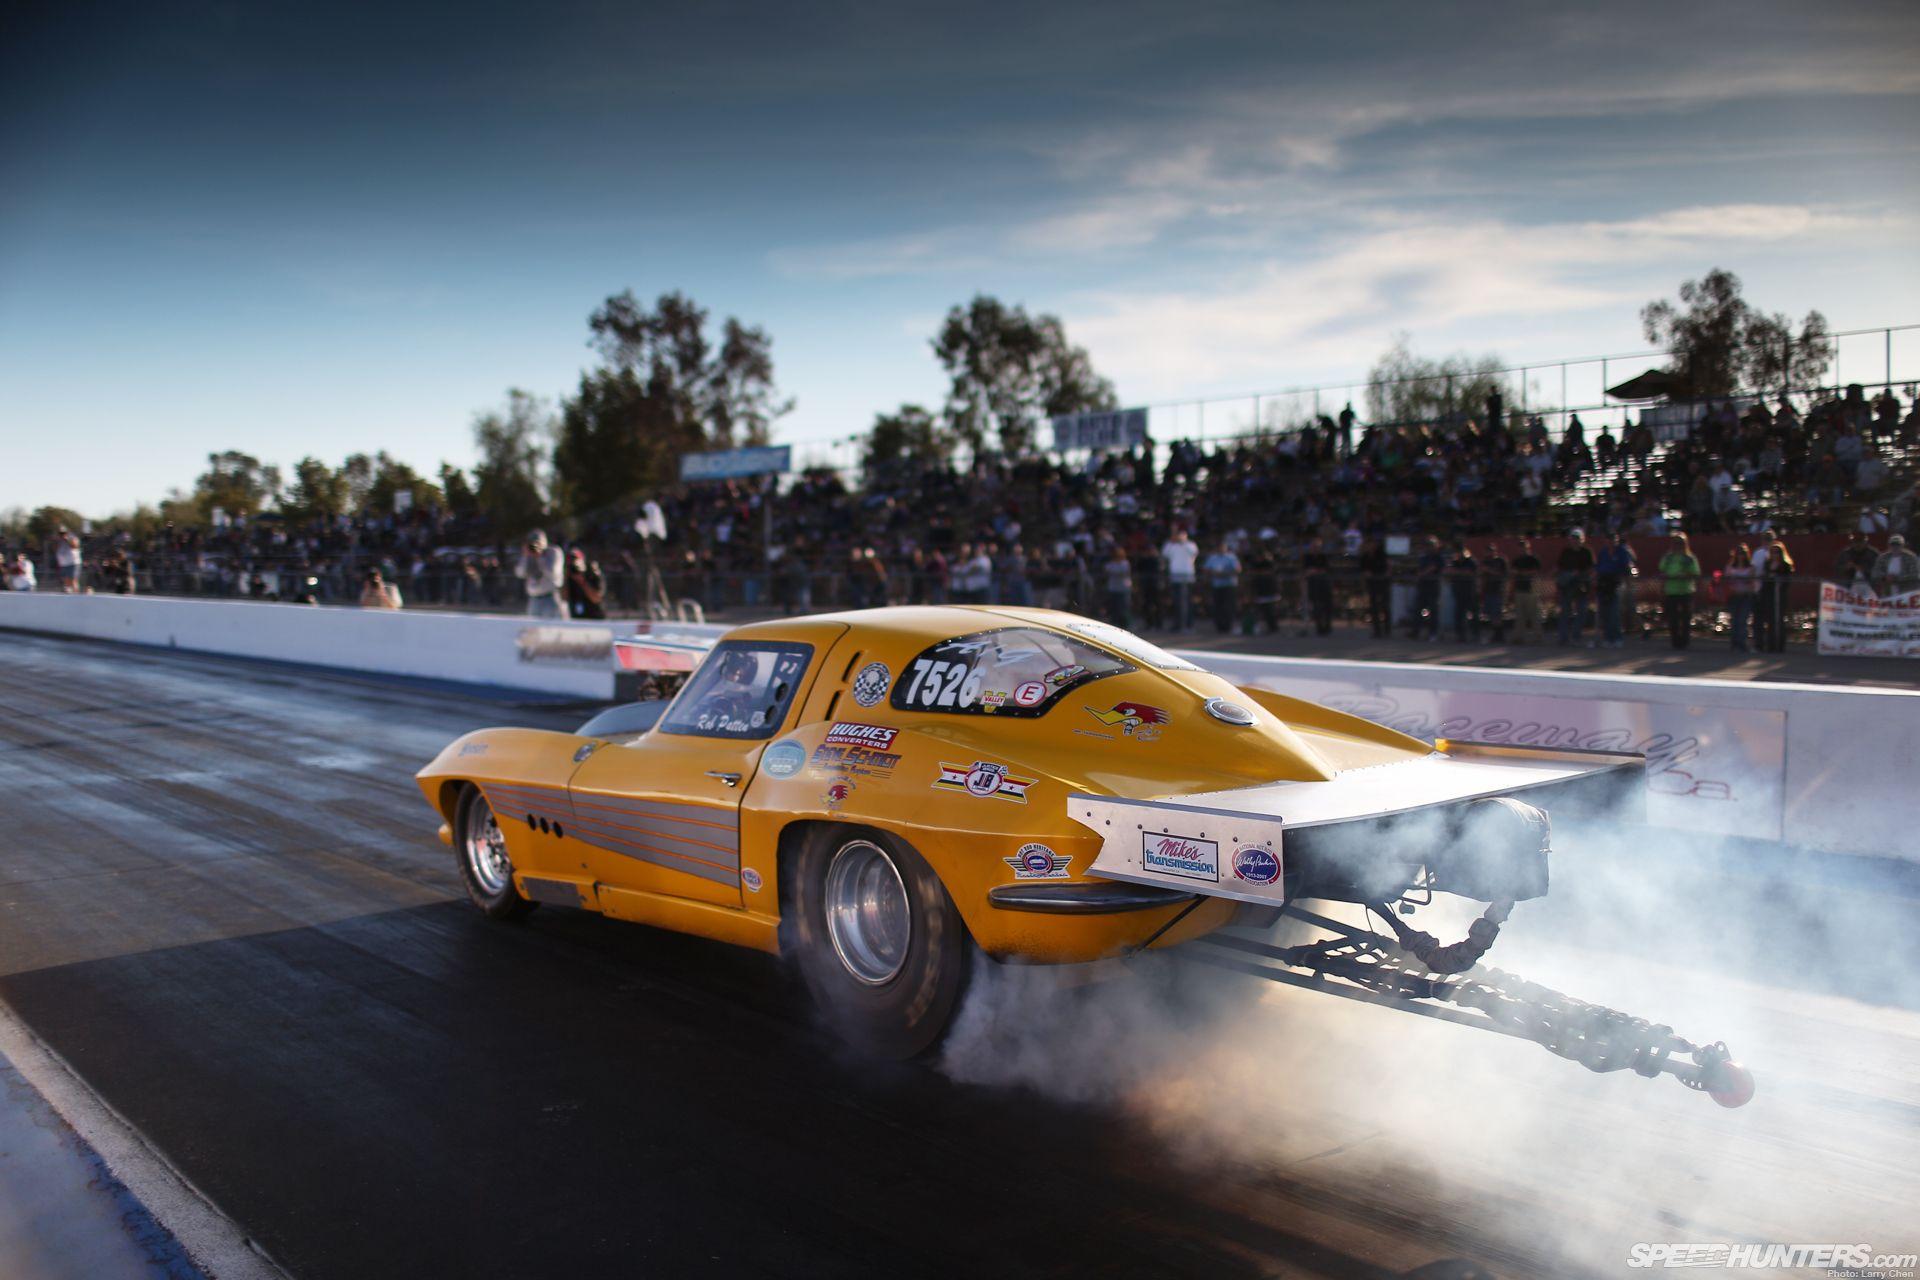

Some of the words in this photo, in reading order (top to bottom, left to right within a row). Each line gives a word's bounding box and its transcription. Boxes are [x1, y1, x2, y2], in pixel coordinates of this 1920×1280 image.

[906, 659, 986, 708] 7526
[1021, 686, 1039, 701] E
[828, 723, 898, 741] HUGHES
[826, 736, 888, 749] CONVERTERS
[1156, 838, 1204, 861] Mike's
